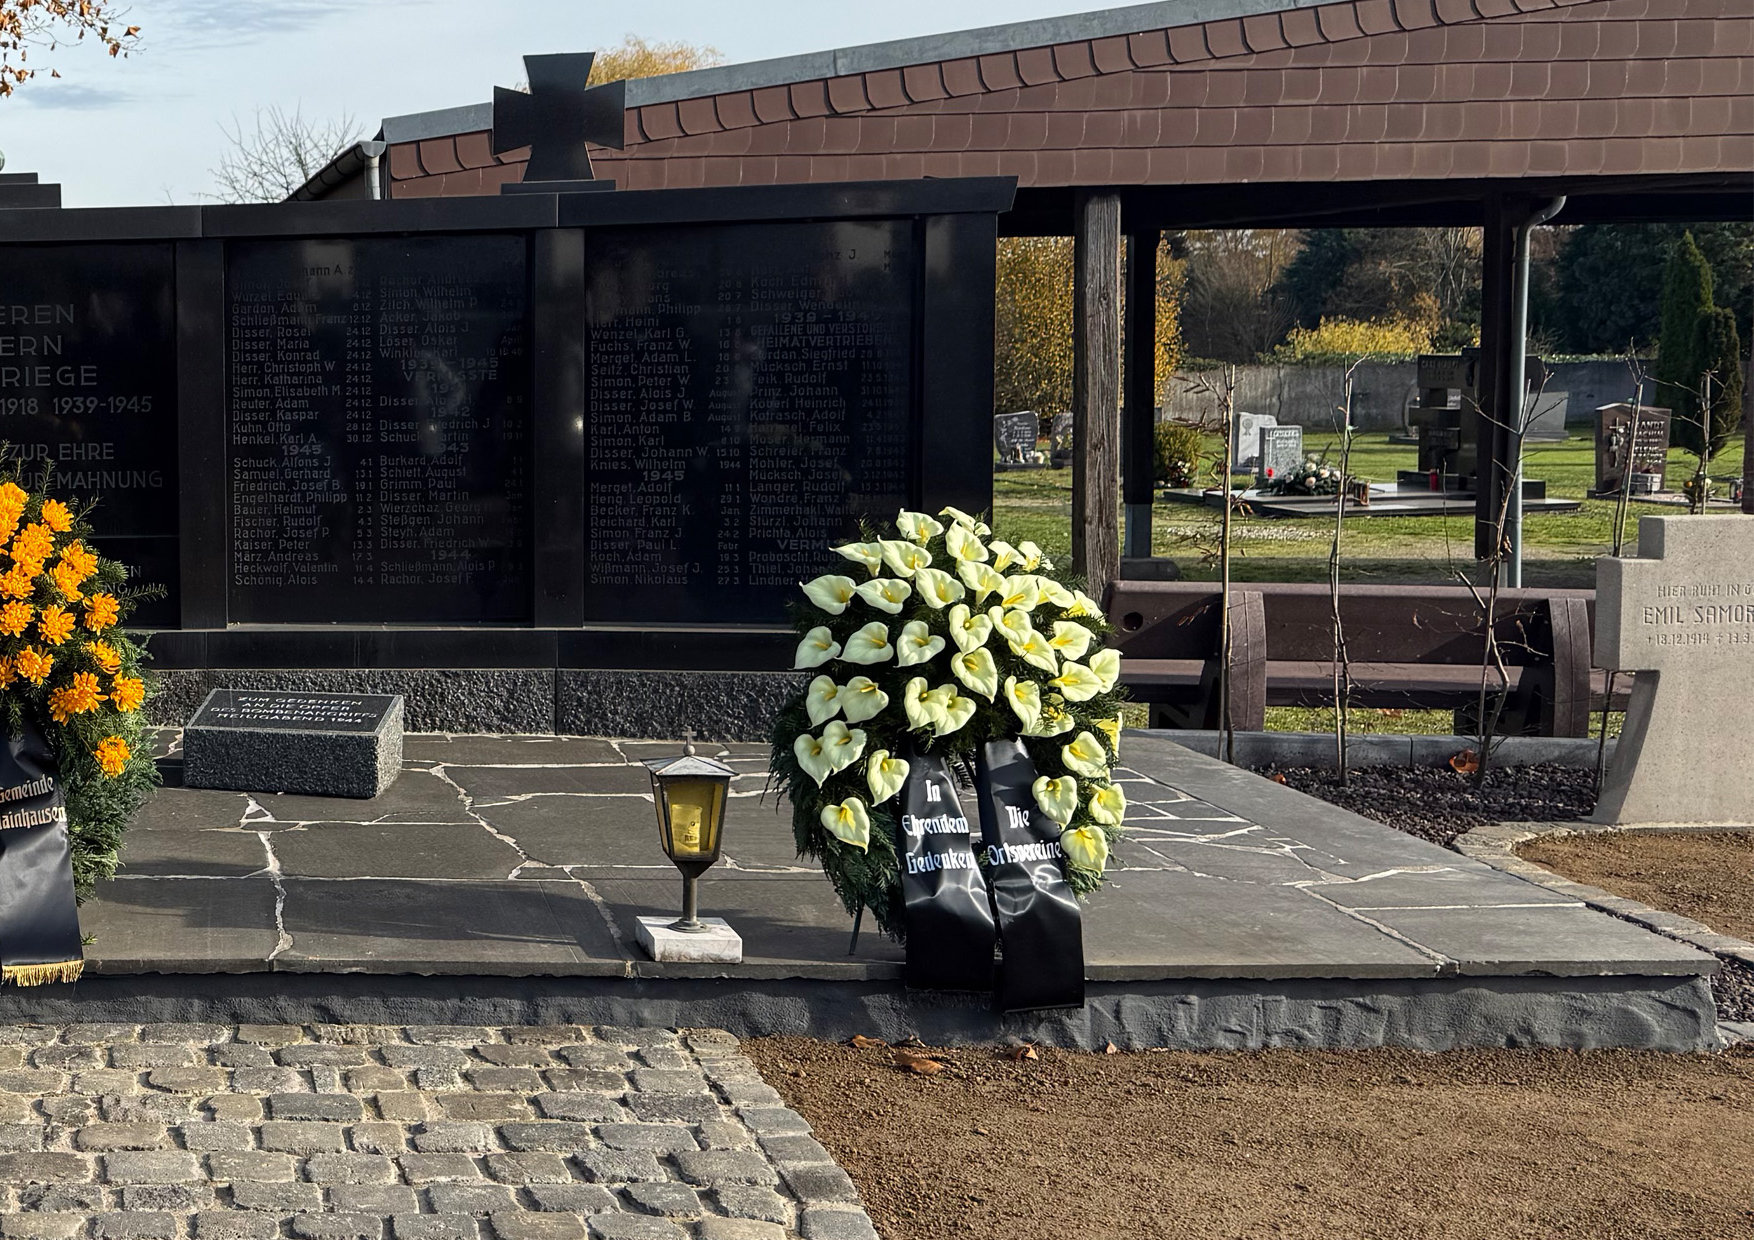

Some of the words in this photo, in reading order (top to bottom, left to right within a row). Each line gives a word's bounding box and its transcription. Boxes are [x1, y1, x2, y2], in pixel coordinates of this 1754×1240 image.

[277, 350, 319, 360] Konrad
[53, 396, 152, 414] 1939-1945
[9, 444, 48, 461] ZUR
[58, 443, 114, 460] EHRE
[282, 444, 322, 455] 1945
[56, 471, 162, 489] MAHNUNG
[643, 471, 684, 481] 1945
[1657, 585, 1686, 597] HIER
[1692, 585, 1720, 596] RUHT
[1726, 584, 1740, 596] IN
[1644, 607, 1684, 624] EMIL
[218, 714, 324, 722] HEILIGABEND
[242, 708, 377, 718] BOMBENANGRIFFS
[926, 780, 941, 802] In
[902, 814, 969, 836] Ehrendem
[1006, 806, 1029, 829] Die
[906, 848, 975, 874] Gedenken
[987, 841, 1061, 866] Ortsvereine
